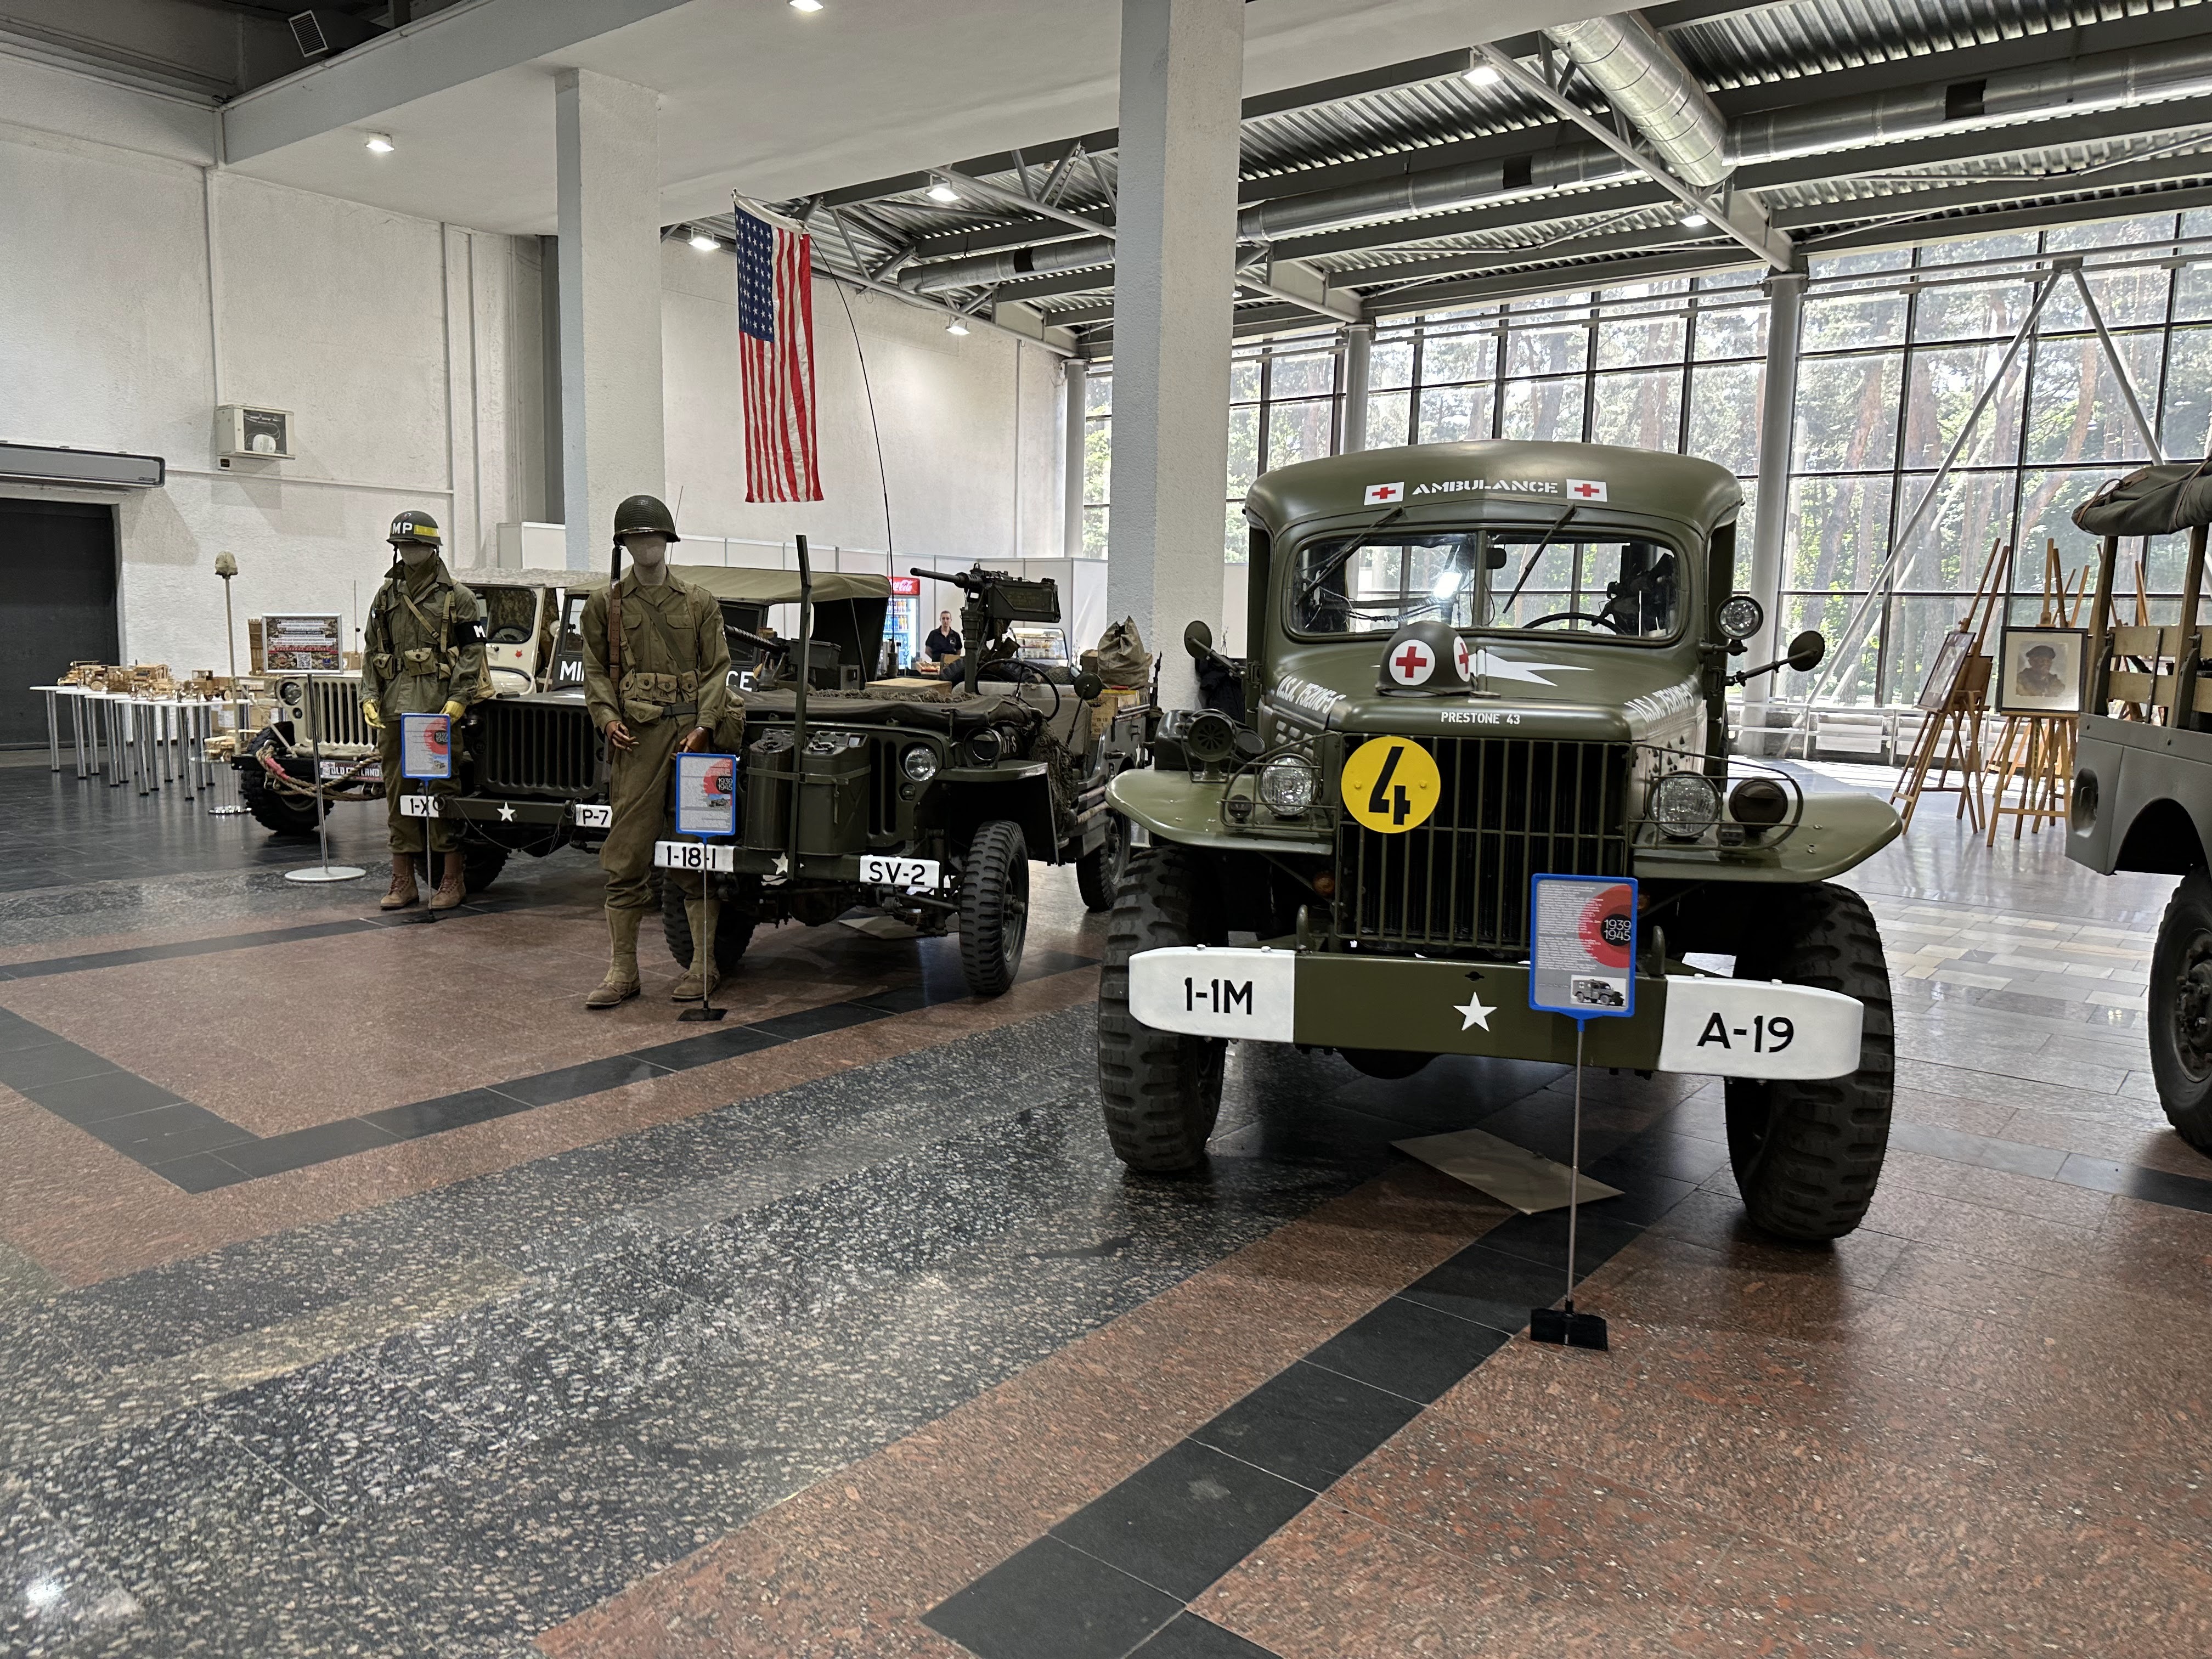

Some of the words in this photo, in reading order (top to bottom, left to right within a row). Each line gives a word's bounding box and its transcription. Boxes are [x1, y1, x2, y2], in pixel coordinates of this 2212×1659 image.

[1412, 479, 1558, 495] AMBULANCE
[392, 522, 413, 534] MP
[725, 670, 754, 692] CE
[1441, 712, 1500, 724] PRESTONE
[1506, 714, 1520, 725] 43
[1368, 746, 1410, 825] 4
[583, 809, 608, 825] P-7
[868, 861, 925, 885] SV-2
[1603, 918, 1632, 931] 1939
[1602, 929, 1632, 941] 1945
[1184, 977, 1252, 1015] 1-1M
[1696, 1012, 1794, 1053] A-19
